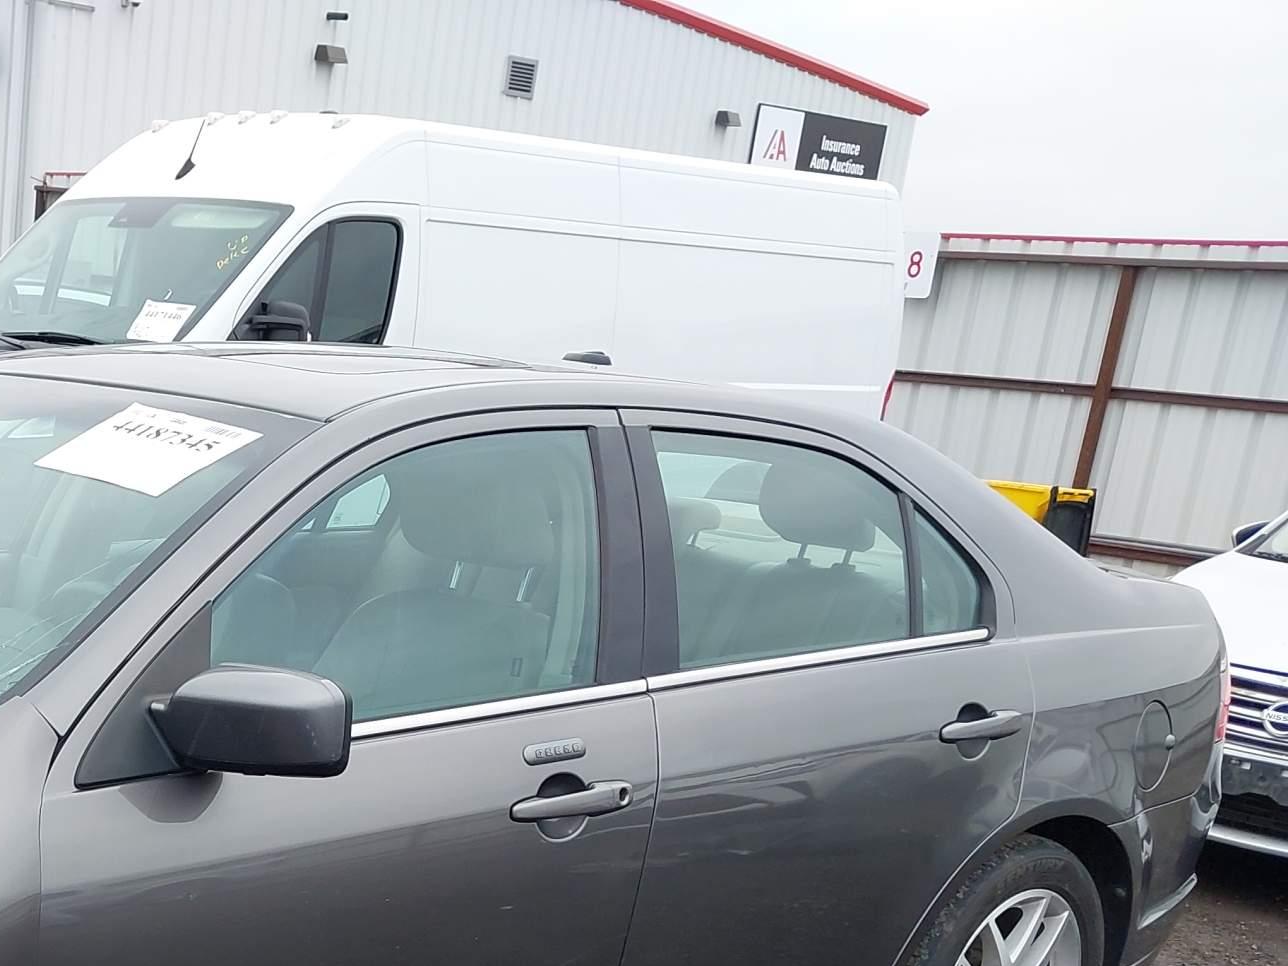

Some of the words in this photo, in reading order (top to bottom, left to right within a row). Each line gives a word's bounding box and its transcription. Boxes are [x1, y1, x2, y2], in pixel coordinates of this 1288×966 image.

[821, 134, 861, 155] Insurance
[810, 153, 829, 170] Auto
[830, 156, 865, 176] Auctions
[907, 250, 923, 278] 8
[112, 419, 221, 452] 44187345
